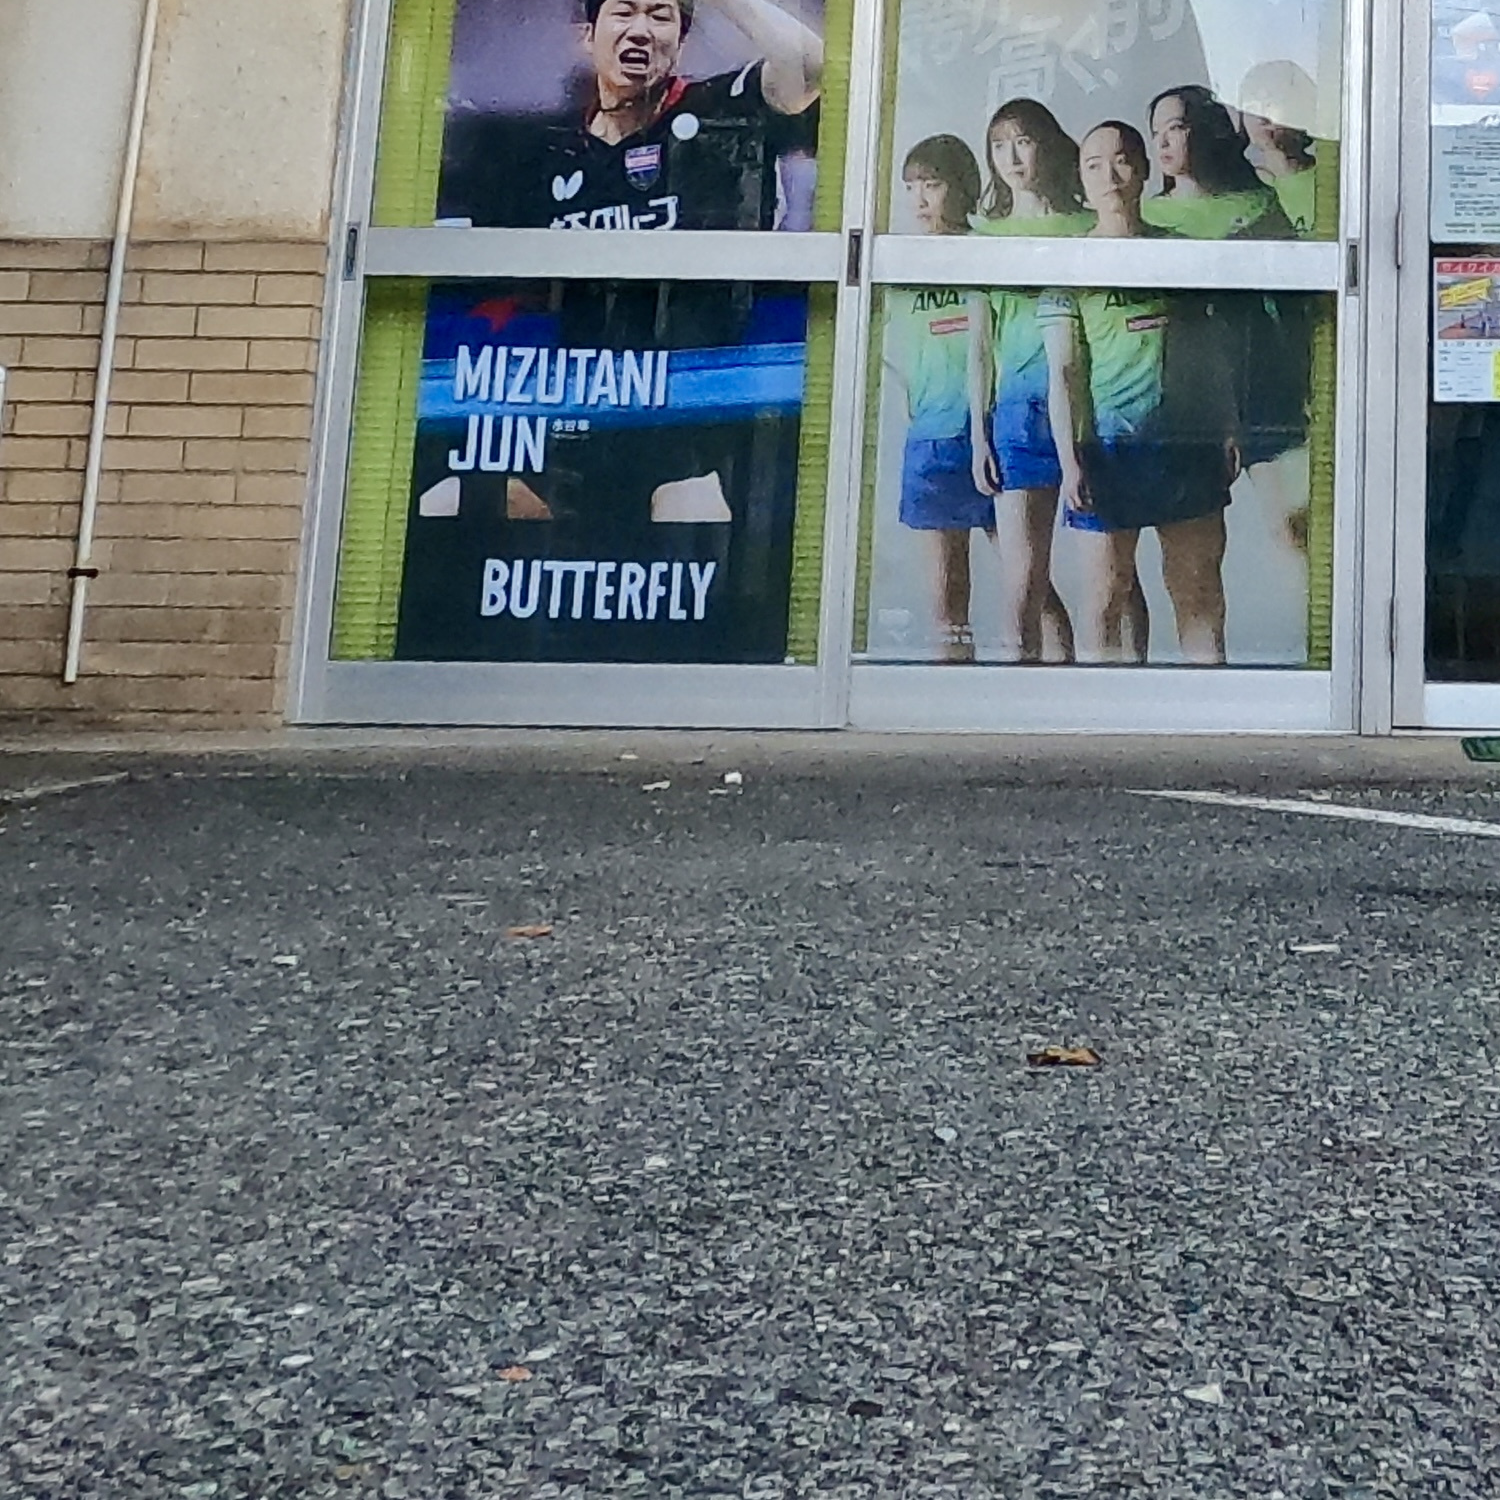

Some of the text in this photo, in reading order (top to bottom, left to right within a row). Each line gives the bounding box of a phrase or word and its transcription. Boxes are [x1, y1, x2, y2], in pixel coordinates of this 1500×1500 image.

[453, 344, 669, 408] MIZUTANI
[448, 414, 548, 473] JUN
[480, 557, 717, 621] BUTTERFLY
